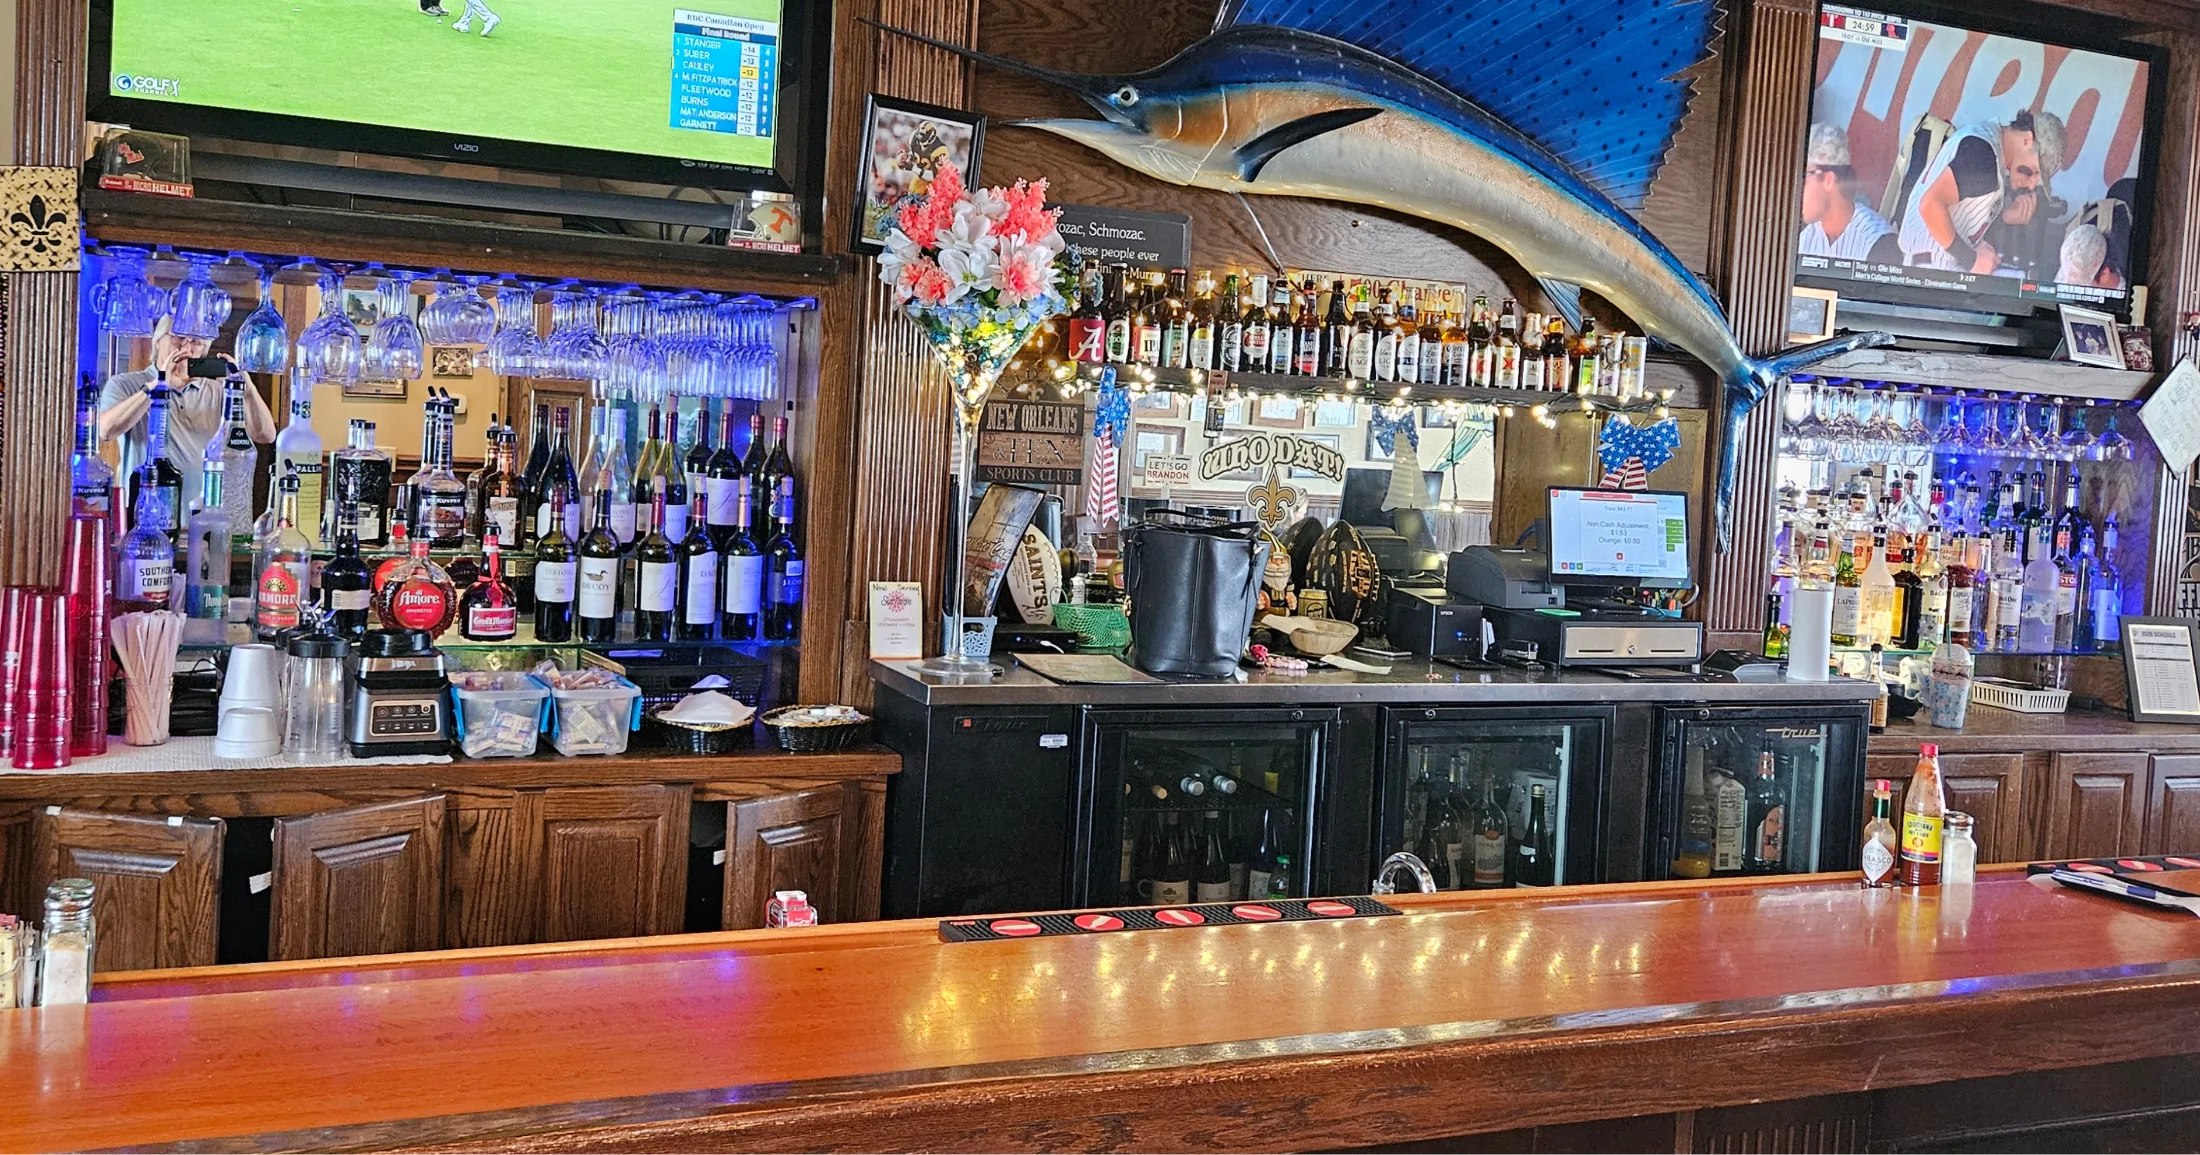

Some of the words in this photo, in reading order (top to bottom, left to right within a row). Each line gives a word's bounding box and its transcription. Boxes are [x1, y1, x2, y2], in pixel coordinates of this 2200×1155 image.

[744, 22, 765, 31] Open
[1852, 21, 1875, 32] 24:59
[684, 38, 721, 50] STANGER
[683, 49, 710, 60] SUBER
[744, 57, 755, 65] -13
[682, 60, 714, 72] CAULEY
[133, 76, 171, 91] GOLF
[692, 74, 738, 87] FITZPATRICK
[681, 84, 732, 98] FLEETWOOD
[681, 95, 709, 106] BURNS
[698, 108, 737, 121] ANDERSON
[680, 119, 718, 130] GARNETT
[454, 143, 479, 153] VIZIO
[133, 180, 152, 192] MICRO
[152, 182, 192, 196] HELMET
[1056, 223, 1086, 238] rozac,
[1088, 222, 1146, 240] Schmozac.
[767, 244, 800, 254] HELMET
[1101, 247, 1135, 261] people
[1137, 251, 1160, 262] ever
[1856, 262, 1869, 271] Troy
[1877, 264, 1889, 273] Ole
[1890, 264, 1902, 274] Miss
[1871, 272, 1890, 284] College
[1890, 275, 1905, 284] World
[1068, 326, 1102, 362] A
[986, 402, 1018, 430] NEW
[1021, 404, 1078, 434] ORLEANS
[1149, 461, 1174, 470] LET'S
[1174, 462, 1188, 471] GO
[986, 467, 1035, 480] SPORTS
[1040, 468, 1074, 482] CLUB
[1147, 470, 1189, 480] BRANDON
[1022, 534, 1048, 609] SAINTS
[582, 582, 611, 592] DECOY
[872, 584, 888, 592] Now
[1907, 821, 1934, 831] LOUISIANA
